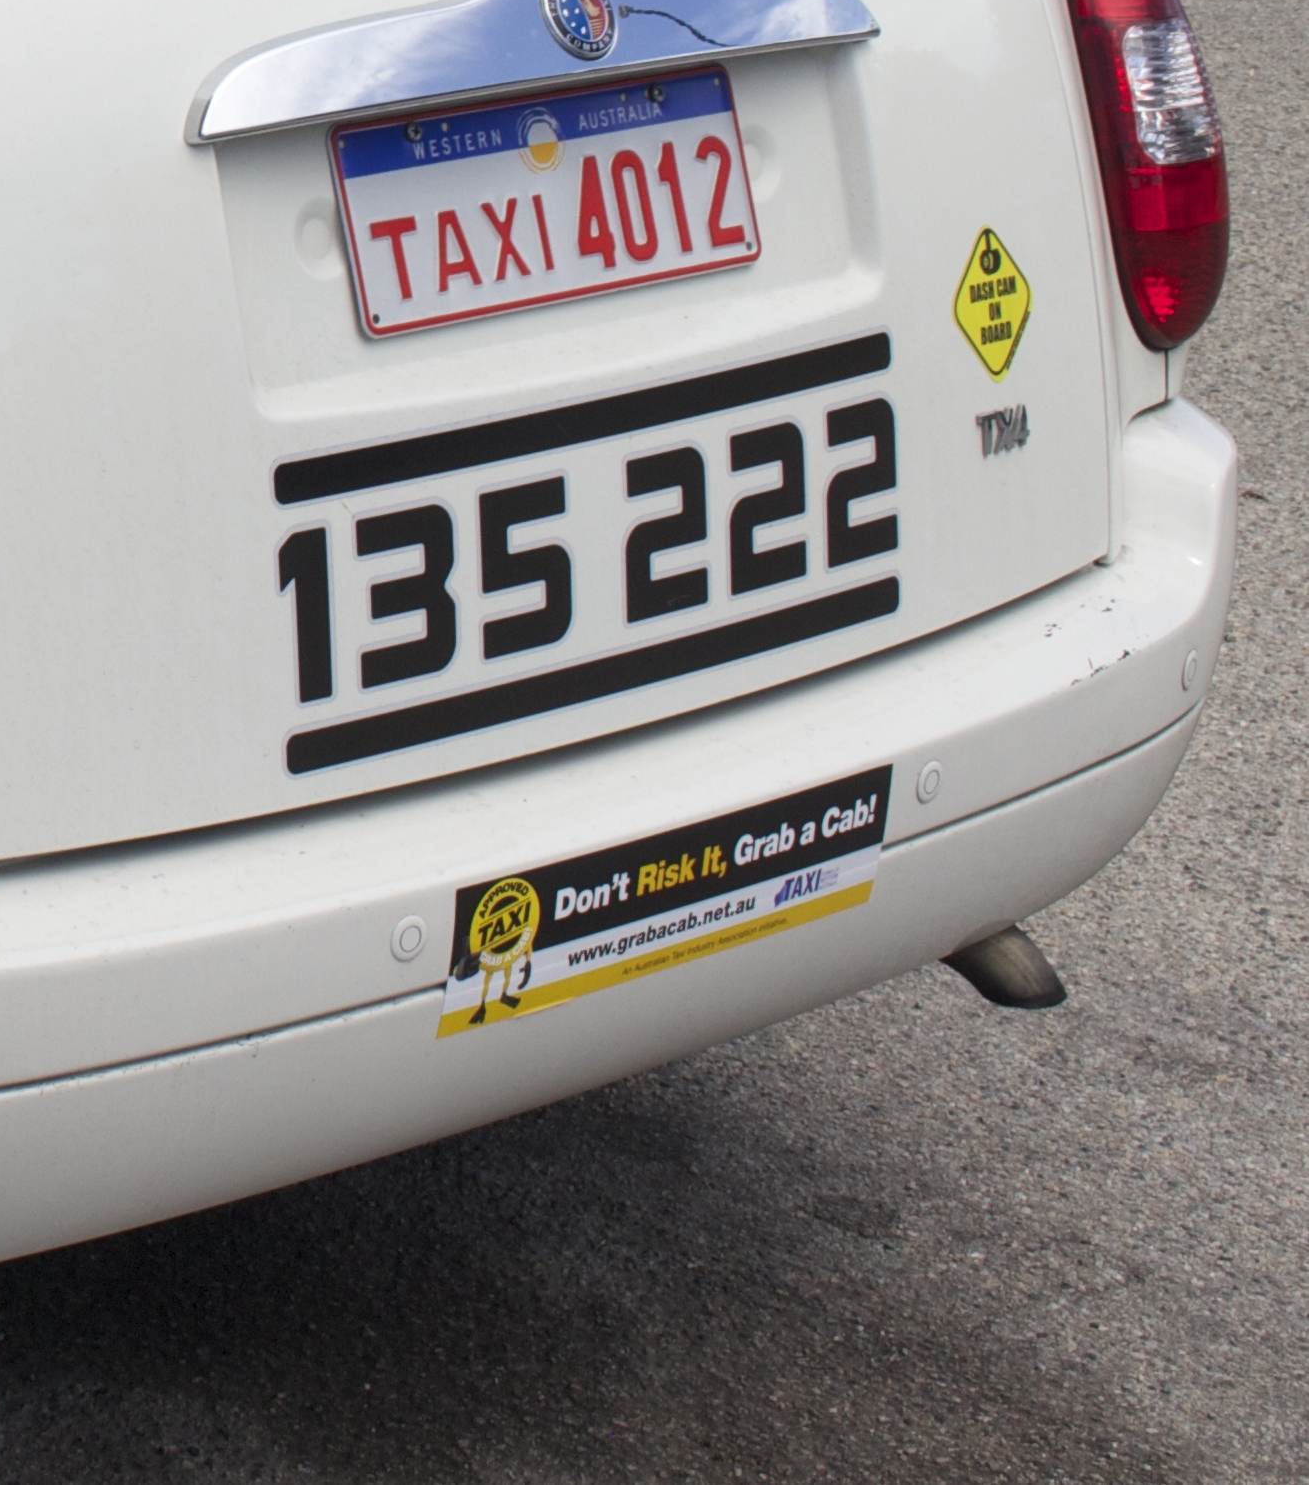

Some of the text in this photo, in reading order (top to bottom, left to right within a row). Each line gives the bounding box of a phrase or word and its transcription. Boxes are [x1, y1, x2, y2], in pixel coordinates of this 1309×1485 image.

[412, 101, 663, 161] WESTERN AUSTRALIA
[369, 134, 746, 300] TAXI 4012
[969, 275, 1017, 304] DASH CAM
[988, 300, 1002, 321] ON
[980, 321, 1012, 345] BOARD
[975, 404, 1031, 459] TX4
[279, 397, 899, 705] 135 222
[554, 793, 878, 921] Don't Risk It, Grab a Cab!
[477, 901, 531, 947] TAXI
[479, 881, 529, 919] APPROVED
[568, 896, 756, 968] www.grabacab.net.au
